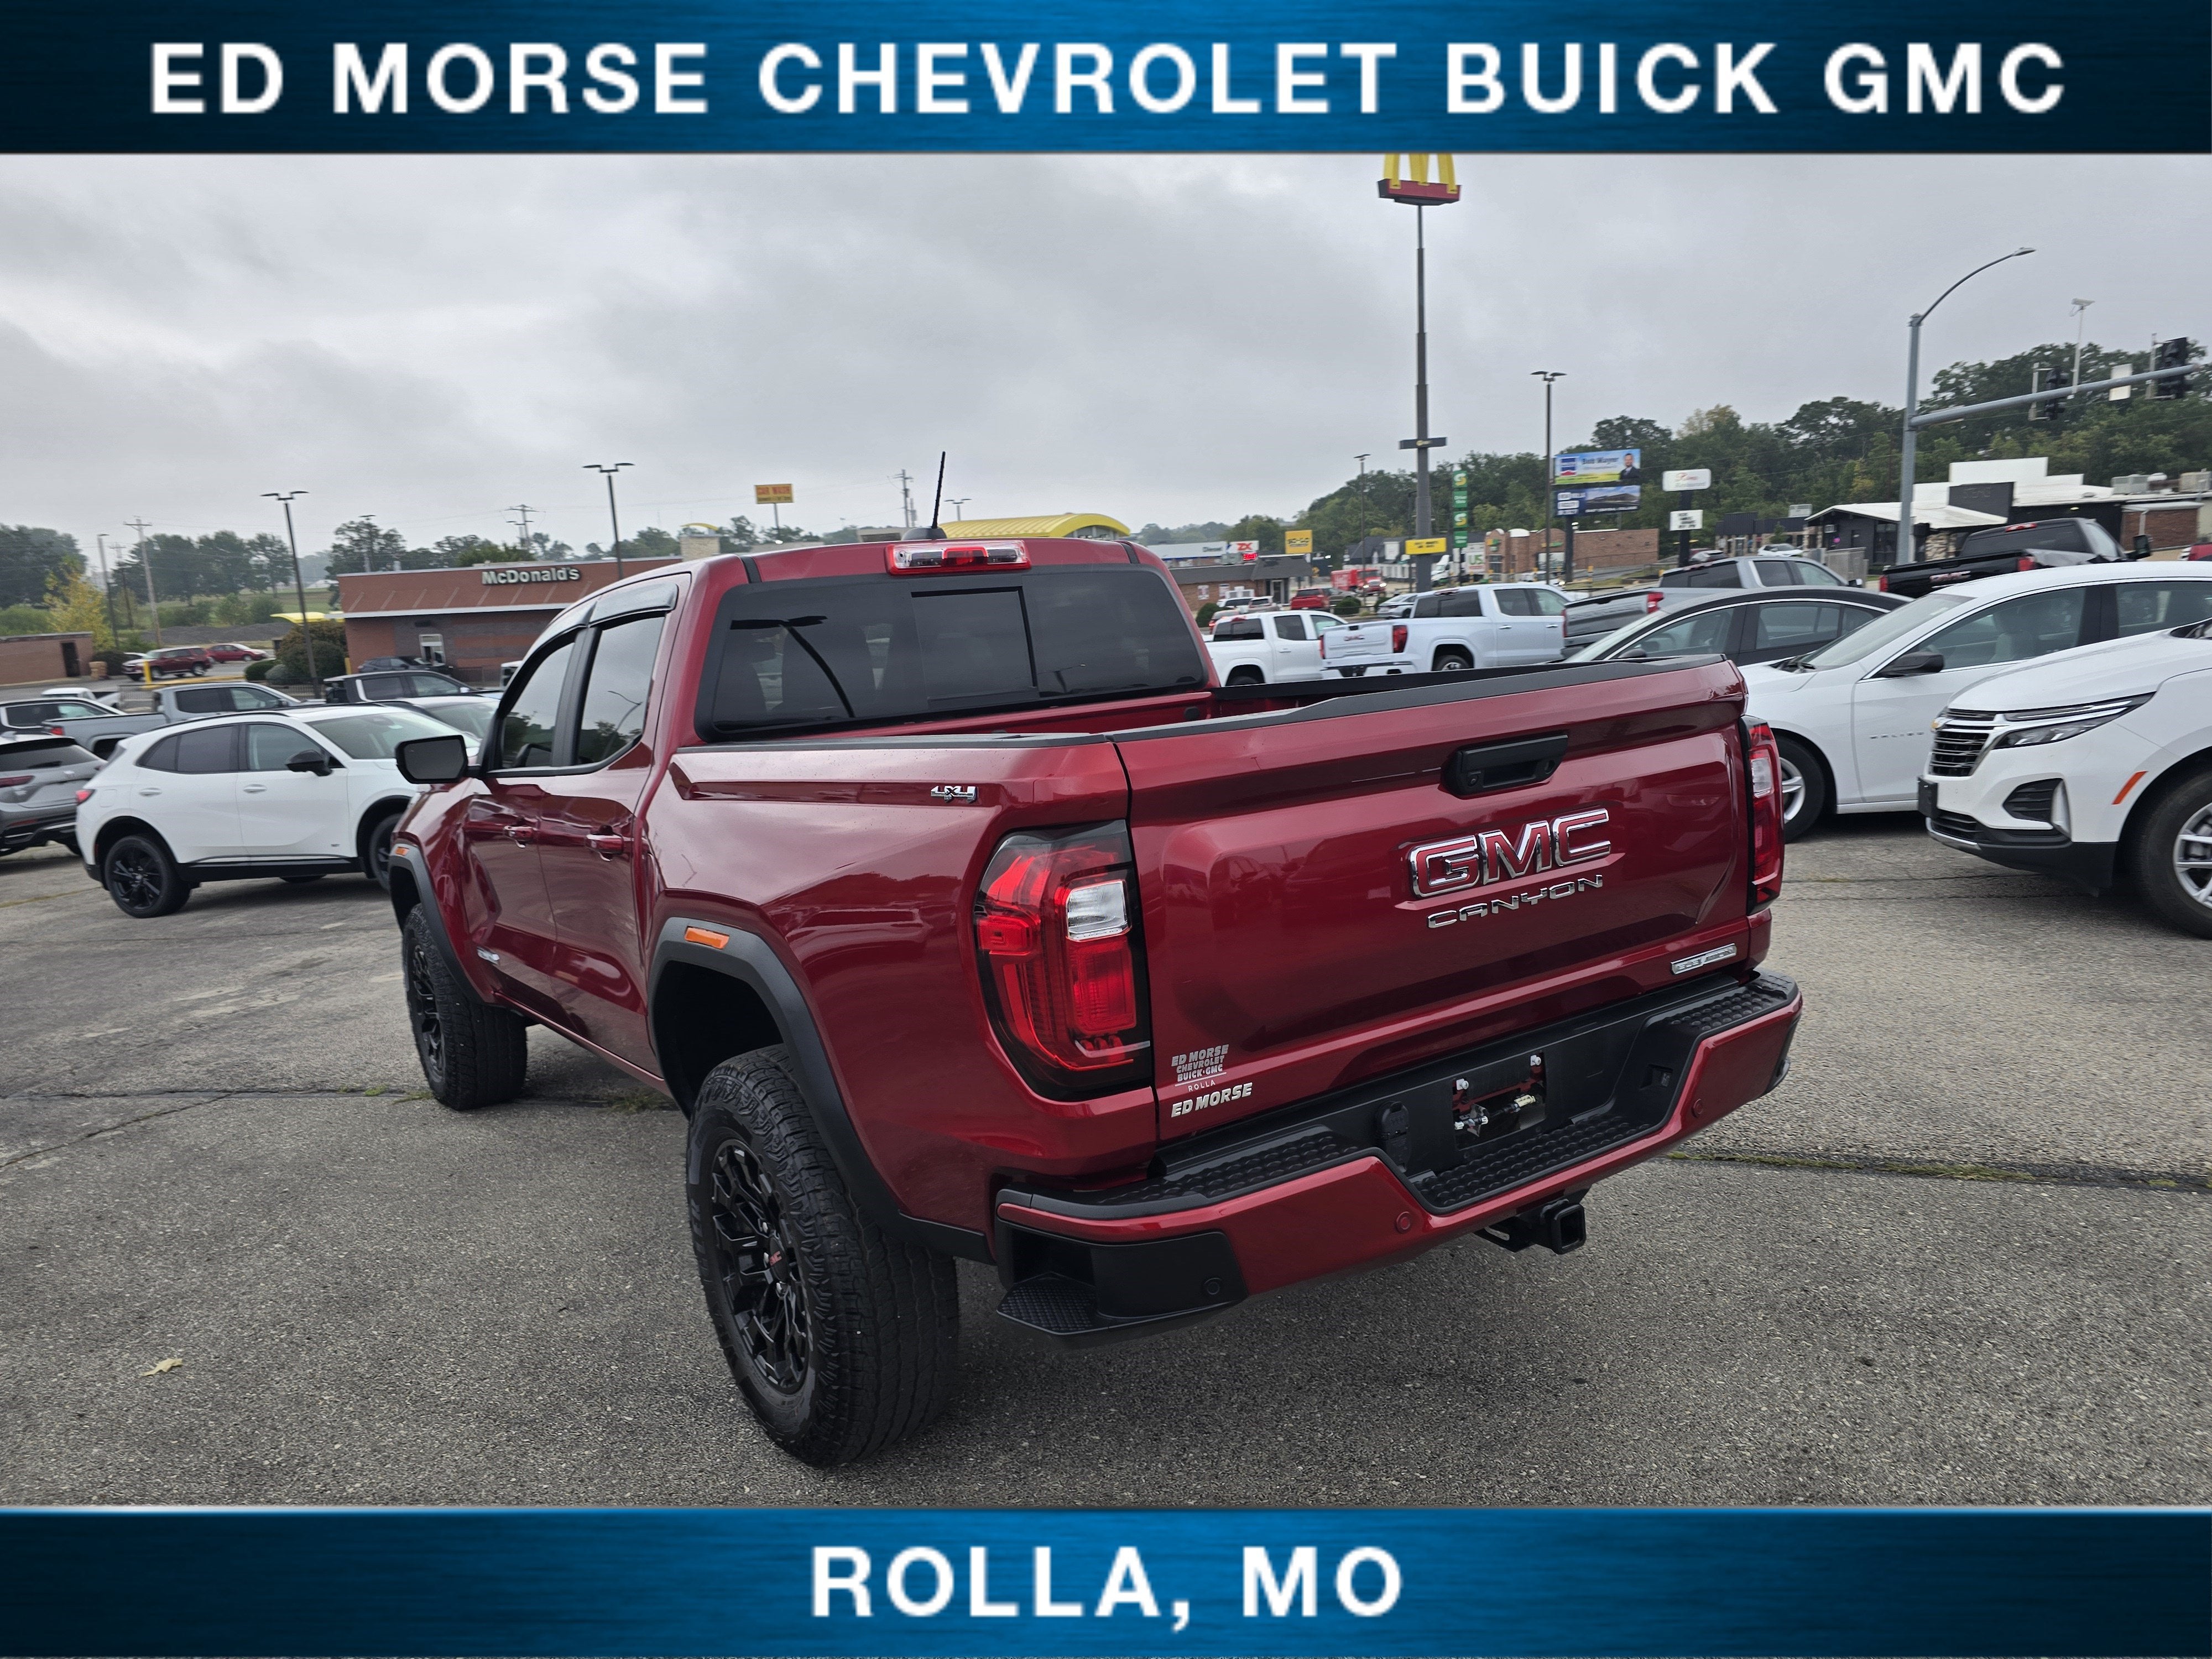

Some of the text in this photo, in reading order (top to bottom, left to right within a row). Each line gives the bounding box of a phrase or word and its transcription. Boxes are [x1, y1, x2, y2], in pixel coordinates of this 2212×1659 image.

[482, 567, 580, 585] McDonald's
[1410, 807, 1612, 899] GMC
[1426, 874, 1603, 929] CANYON
[1171, 1044, 1229, 1067] ED MORSE
[1176, 1055, 1225, 1073] CHEVROLET
[1188, 1079, 1216, 1092] ROLLA
[1171, 1082, 1253, 1118] ED MORSE
